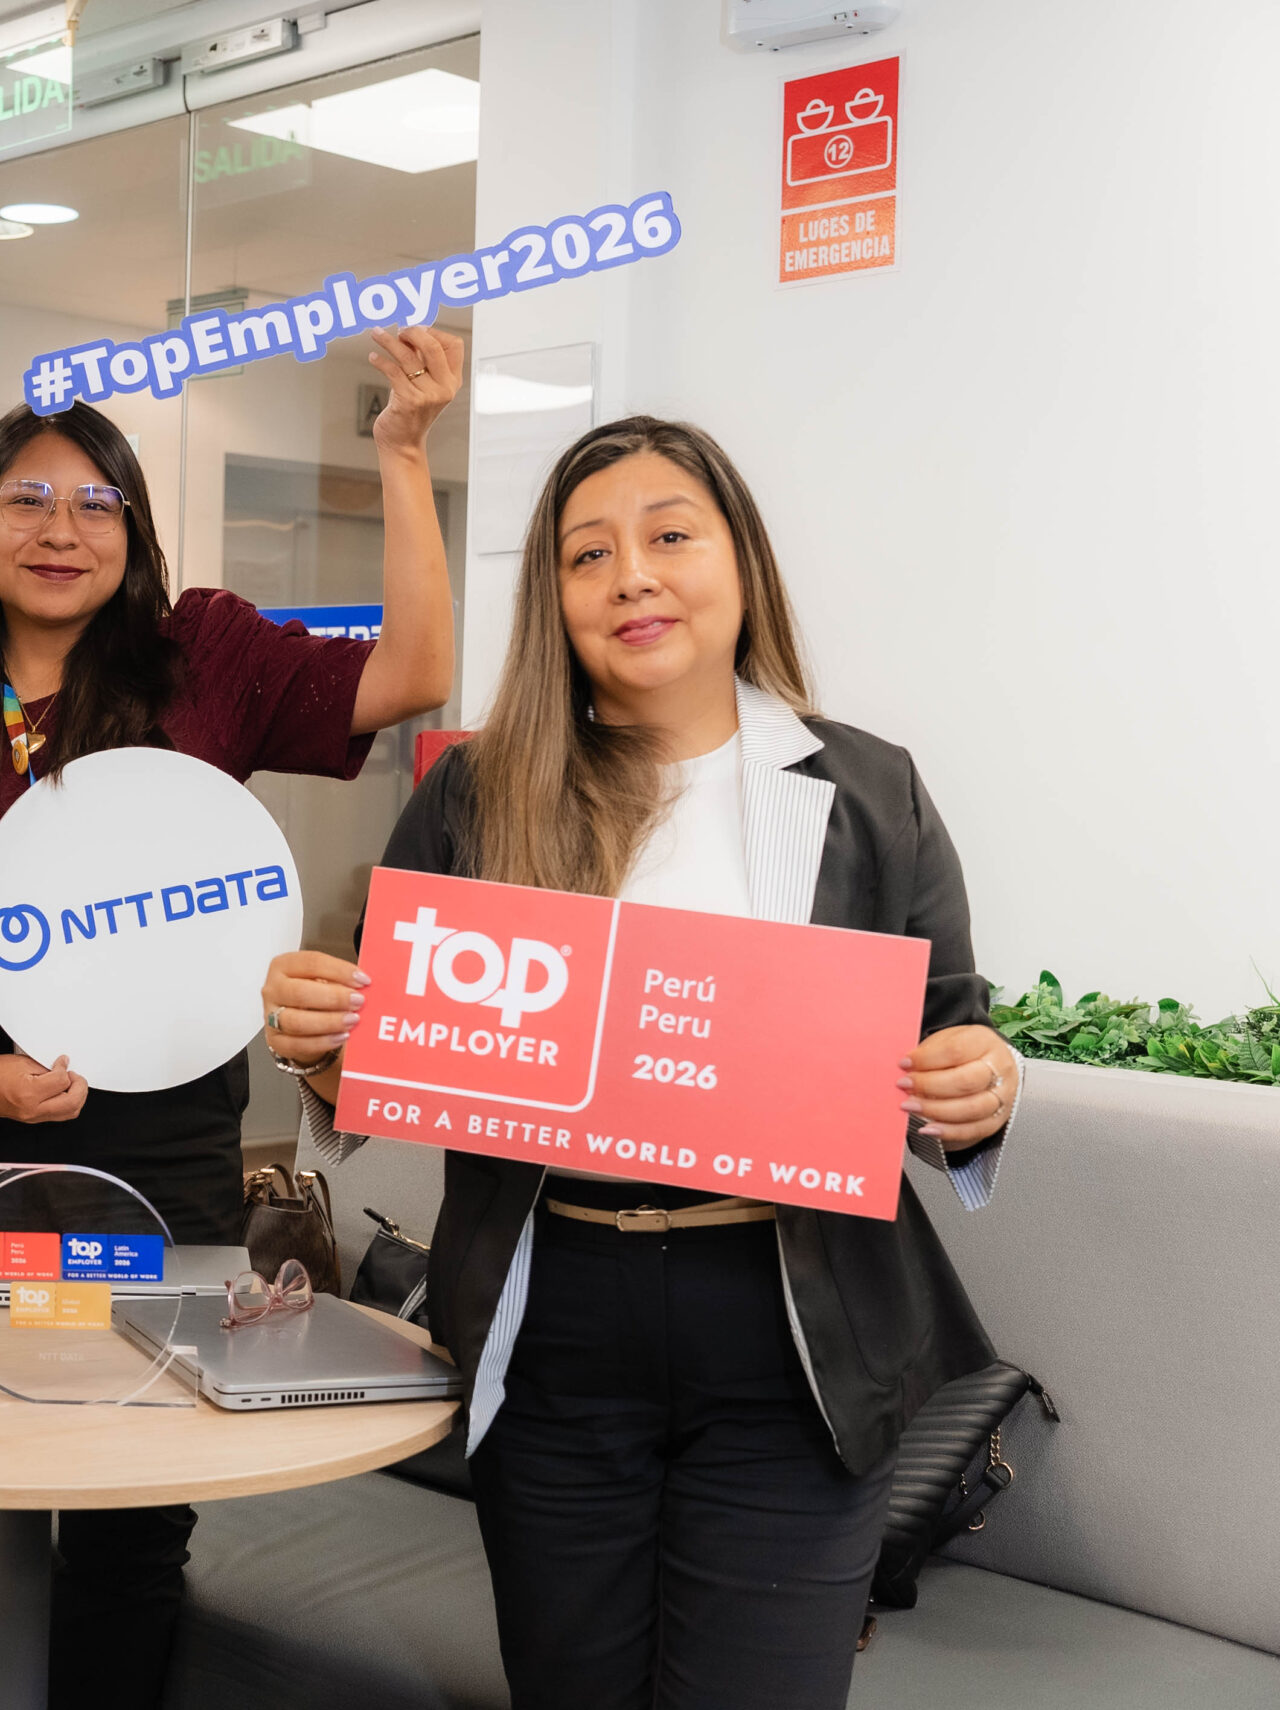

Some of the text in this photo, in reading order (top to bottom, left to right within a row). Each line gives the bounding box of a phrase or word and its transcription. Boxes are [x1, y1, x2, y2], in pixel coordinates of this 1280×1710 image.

[194, 130, 303, 184] SALIDA
[827, 141, 849, 161] 12
[799, 210, 876, 243] LUCES DE
[785, 235, 890, 272] EMERGENCIA
[31, 199, 672, 408] #TopEmployer2026
[61, 865, 288, 944] NTT DATA
[393, 906, 569, 1029] top
[644, 968, 716, 1002] Perú
[378, 1015, 559, 1066] EMPLOYER
[639, 1004, 711, 1039] Peru
[632, 1054, 718, 1090] 2026
[367, 1098, 865, 1196] FOR A BETTER WORLD OF WORK
